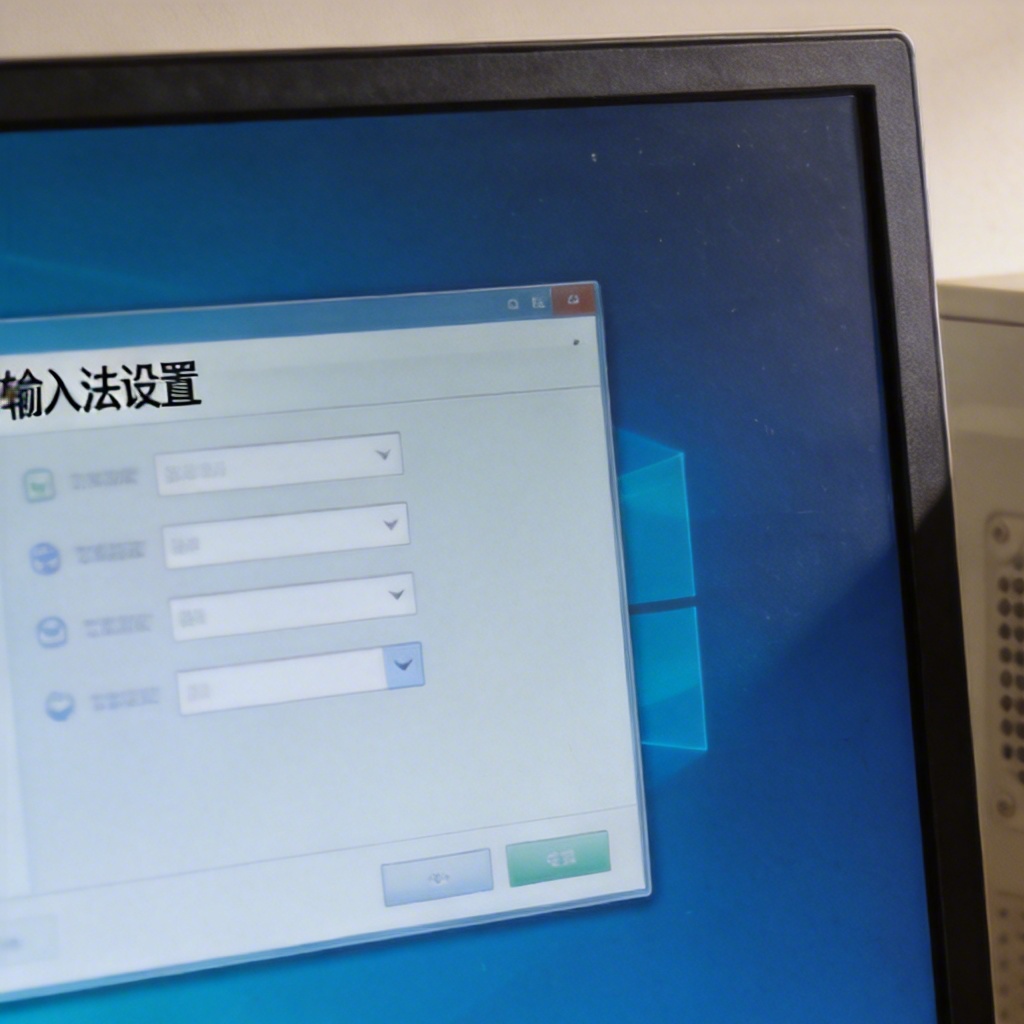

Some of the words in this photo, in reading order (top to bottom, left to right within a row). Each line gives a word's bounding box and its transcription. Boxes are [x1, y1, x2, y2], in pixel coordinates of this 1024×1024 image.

[0, 360, 202, 420] 输入法设置
